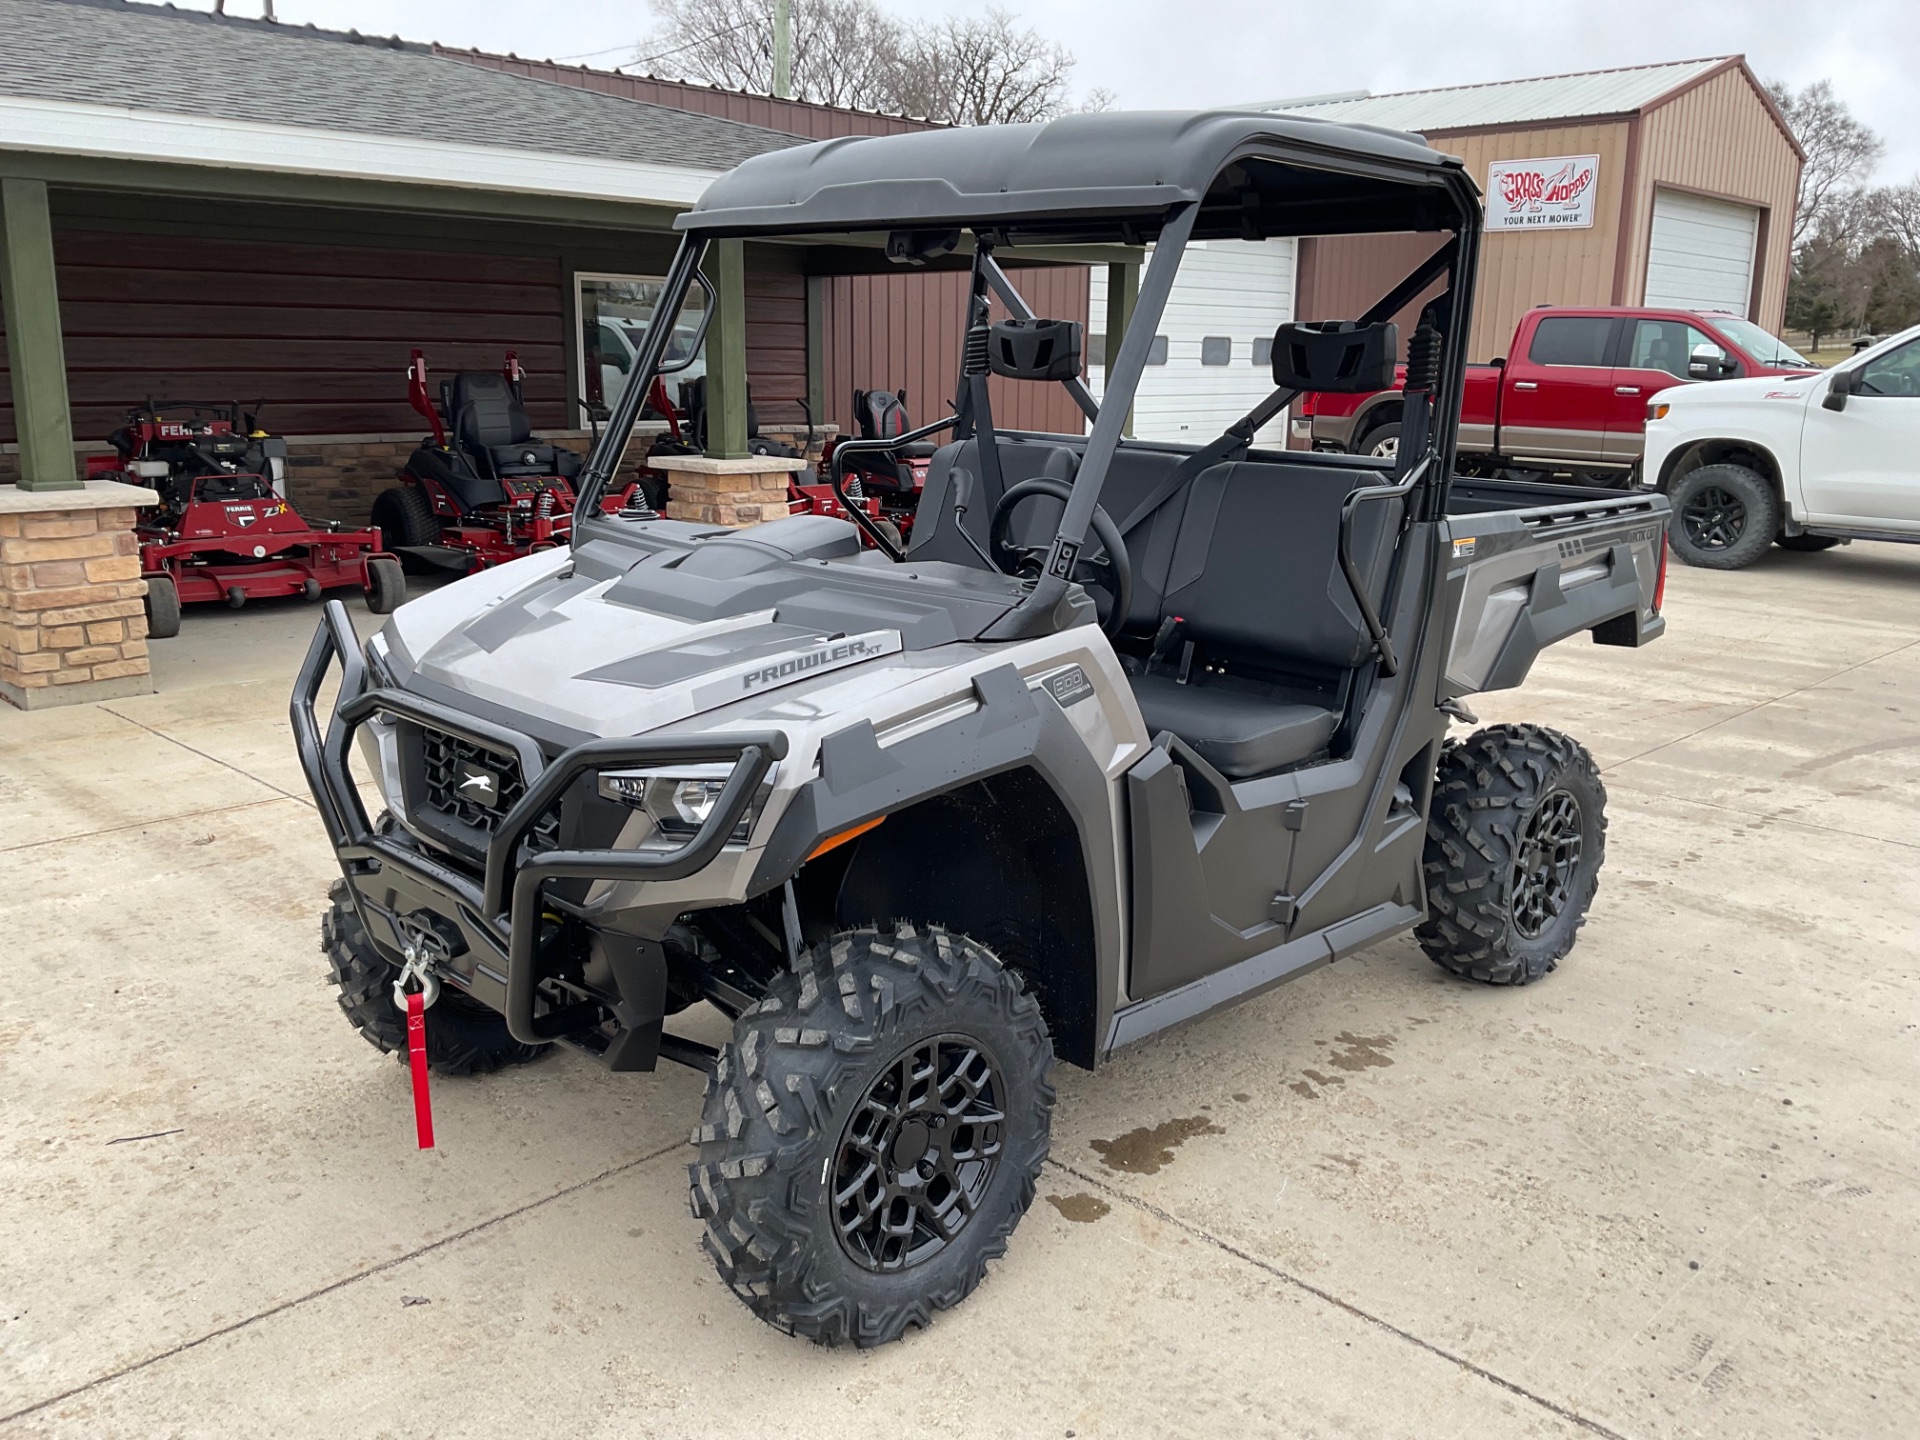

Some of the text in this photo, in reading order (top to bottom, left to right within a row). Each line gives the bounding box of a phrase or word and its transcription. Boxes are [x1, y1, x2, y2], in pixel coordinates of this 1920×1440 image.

[1504, 216, 1524, 226] YOUR
[1527, 214, 1547, 225] NEXT
[743, 641, 882, 689] PROWLER XT
[1053, 668, 1083, 698] 800
